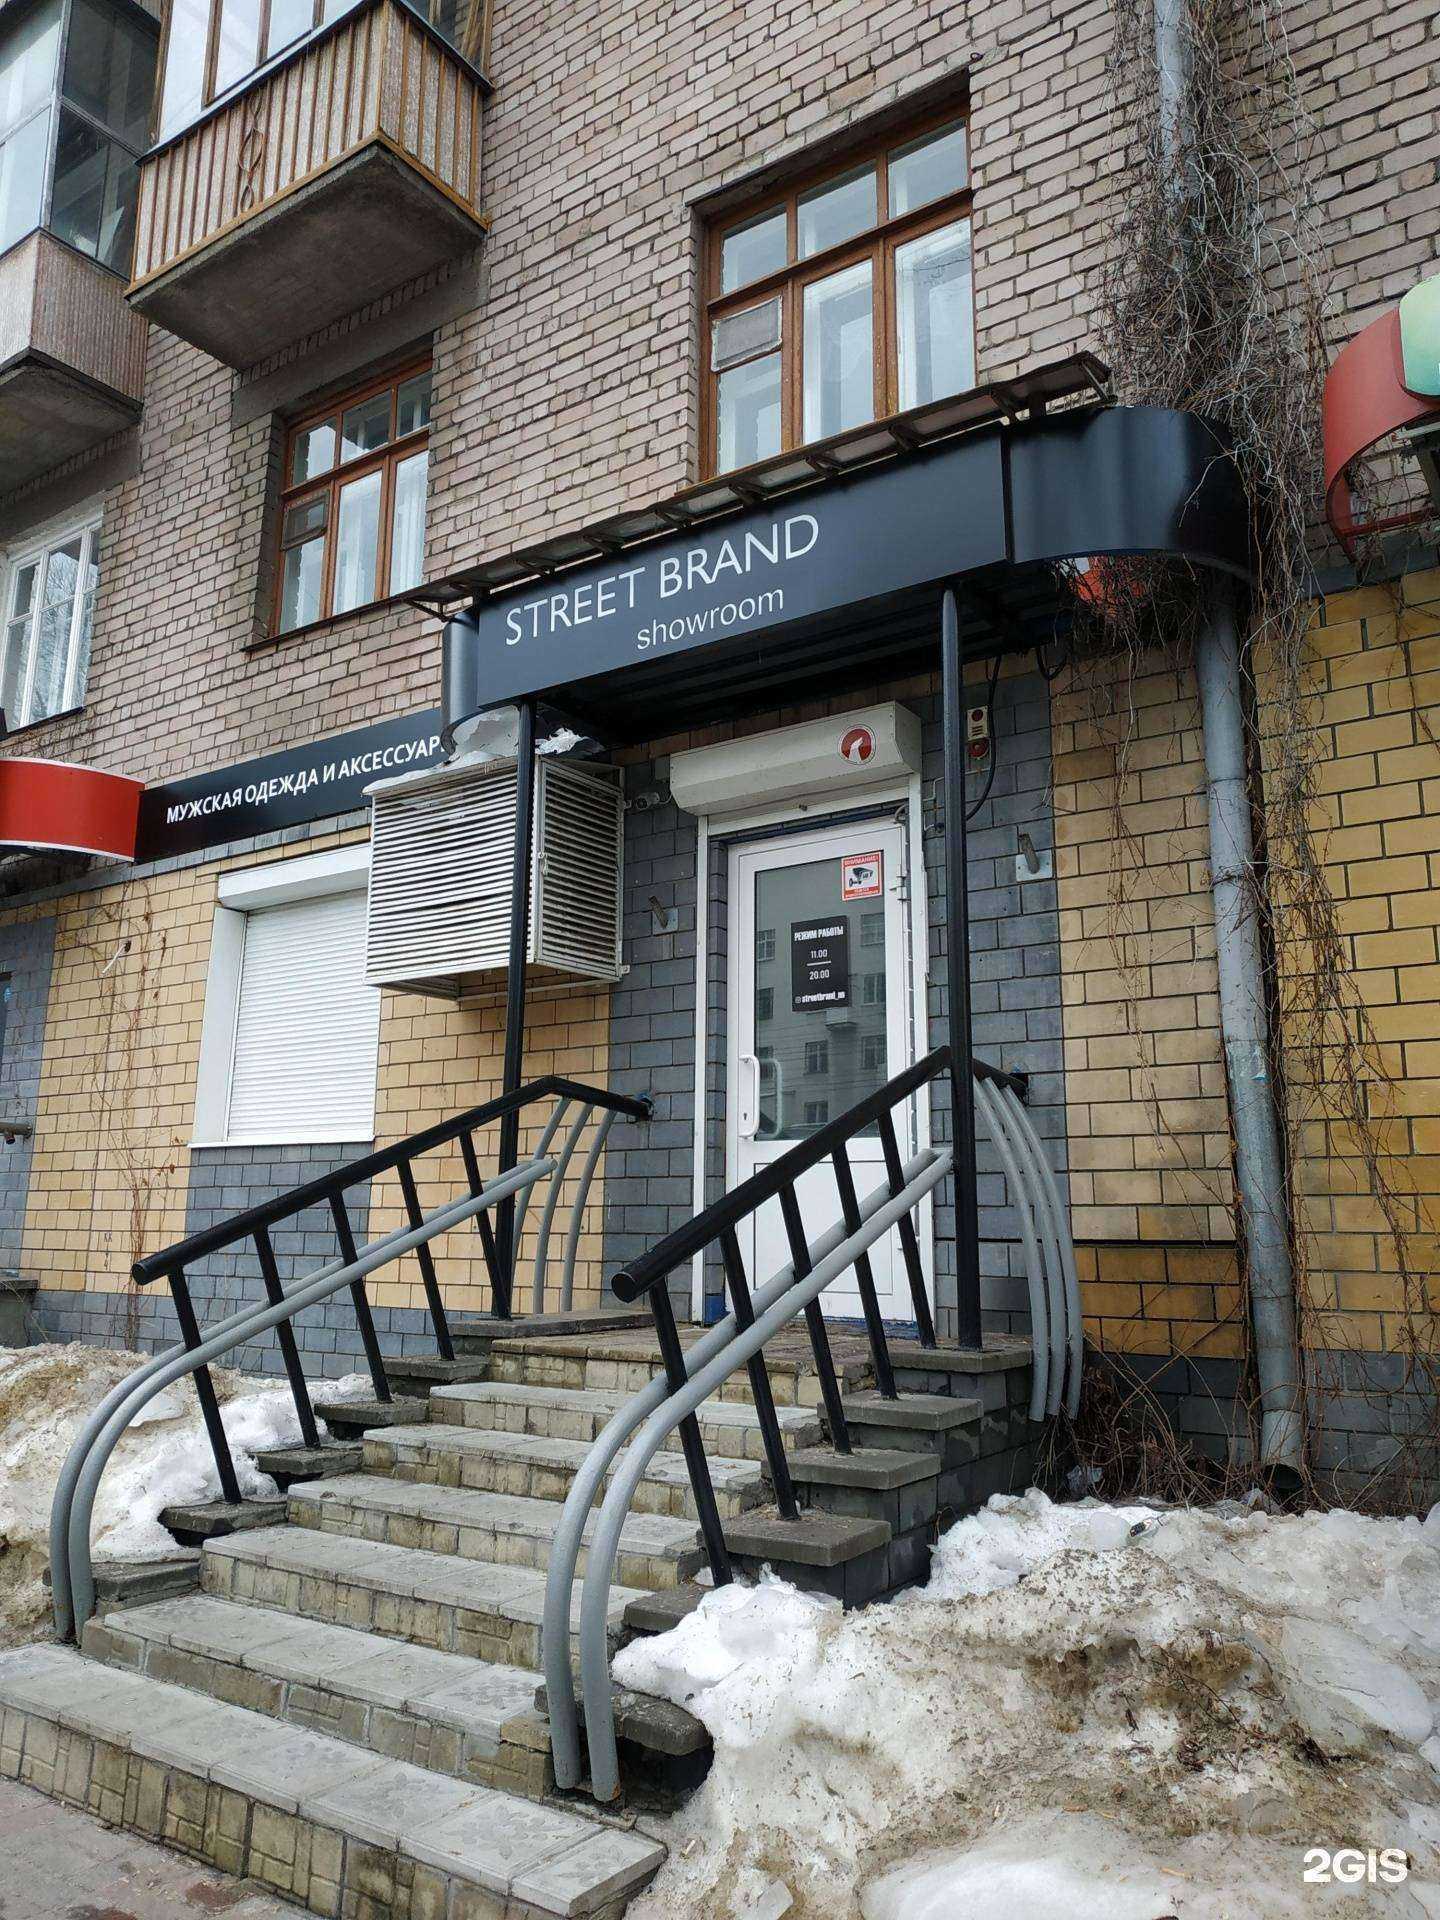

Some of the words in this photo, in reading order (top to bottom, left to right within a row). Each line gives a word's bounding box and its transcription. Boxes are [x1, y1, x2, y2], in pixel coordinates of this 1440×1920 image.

[505, 566, 645, 646] STREET
[659, 514, 819, 599] BRAND
[636, 588, 784, 650] showroom
[166, 788, 242, 824] МУЖСКАЯ
[244, 769, 319, 810] ОДЕЖДА
[322, 762, 336, 784] И
[338, 735, 445, 779] АКСЕССУАР
[794, 929, 817, 942] РЕЖИМ
[818, 926, 844, 938] РАБОТЫ
[810, 949, 828, 959] 11.00
[809, 969, 830, 980] 20.00
